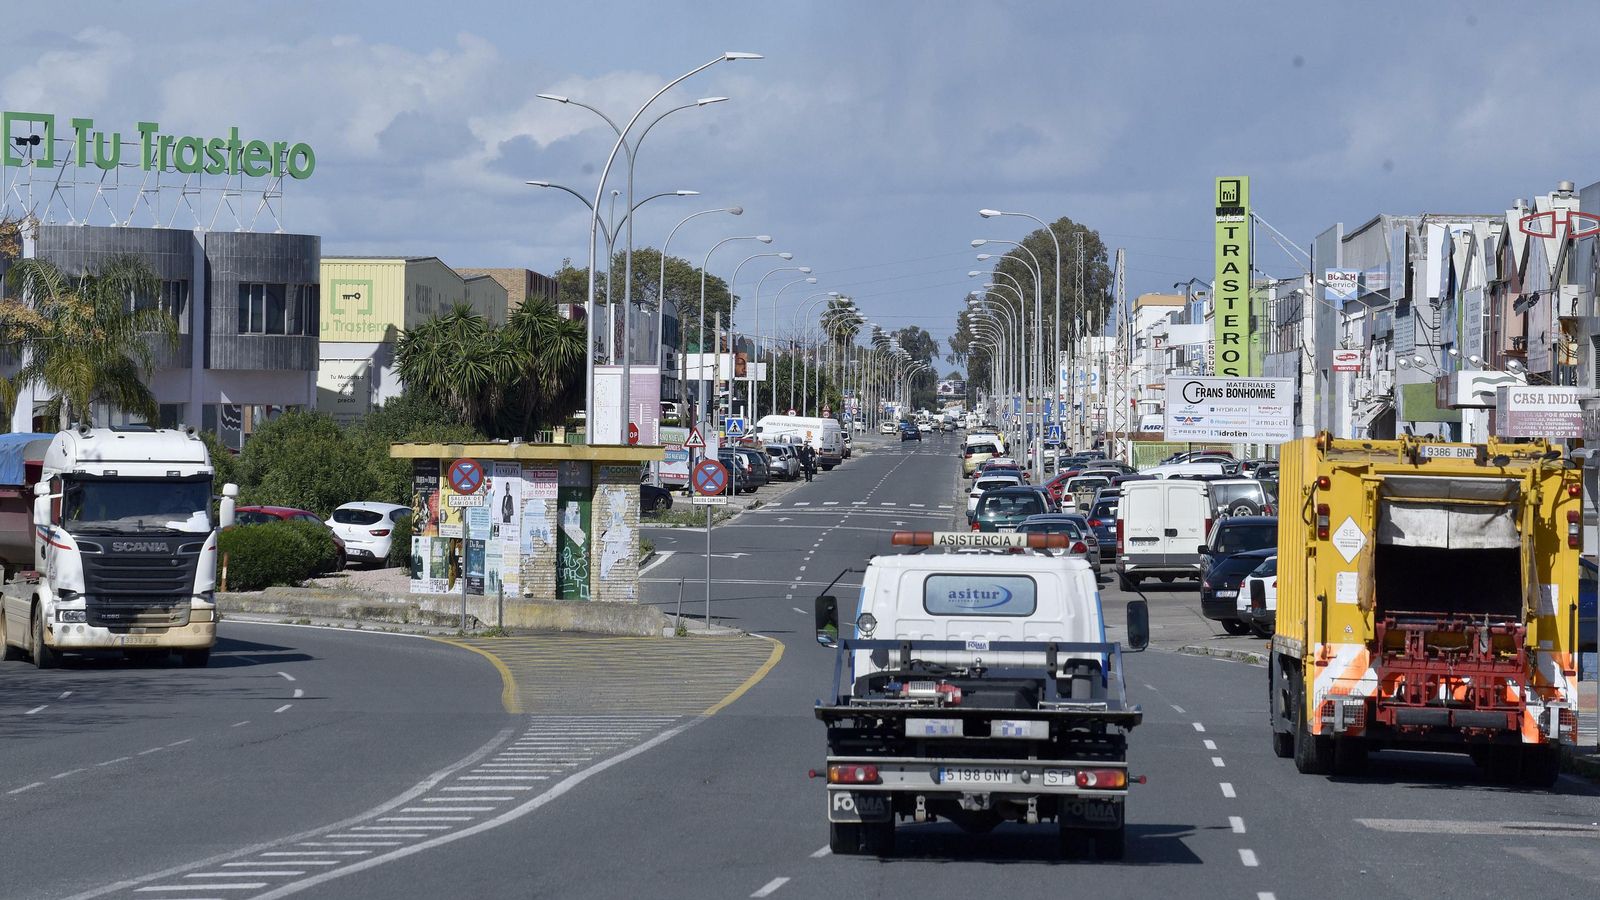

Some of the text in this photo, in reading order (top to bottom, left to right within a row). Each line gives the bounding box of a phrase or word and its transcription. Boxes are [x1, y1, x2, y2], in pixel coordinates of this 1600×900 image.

[72, 118, 316, 180] Tu Trastero
[1222, 189, 1235, 200] mi
[1222, 227, 1241, 377] TRASTEROS
[332, 320, 391, 333] Trastero
[1196, 388, 1276, 399] FRANS BONHOMME
[1513, 393, 1545, 404] CASA
[1428, 447, 1474, 457] 9386 BNR
[940, 535, 1011, 546] ASISTENCIA
[112, 542, 169, 552] SCANIA
[948, 588, 1000, 599] asitur
[947, 769, 1010, 781] 5198 GNY
